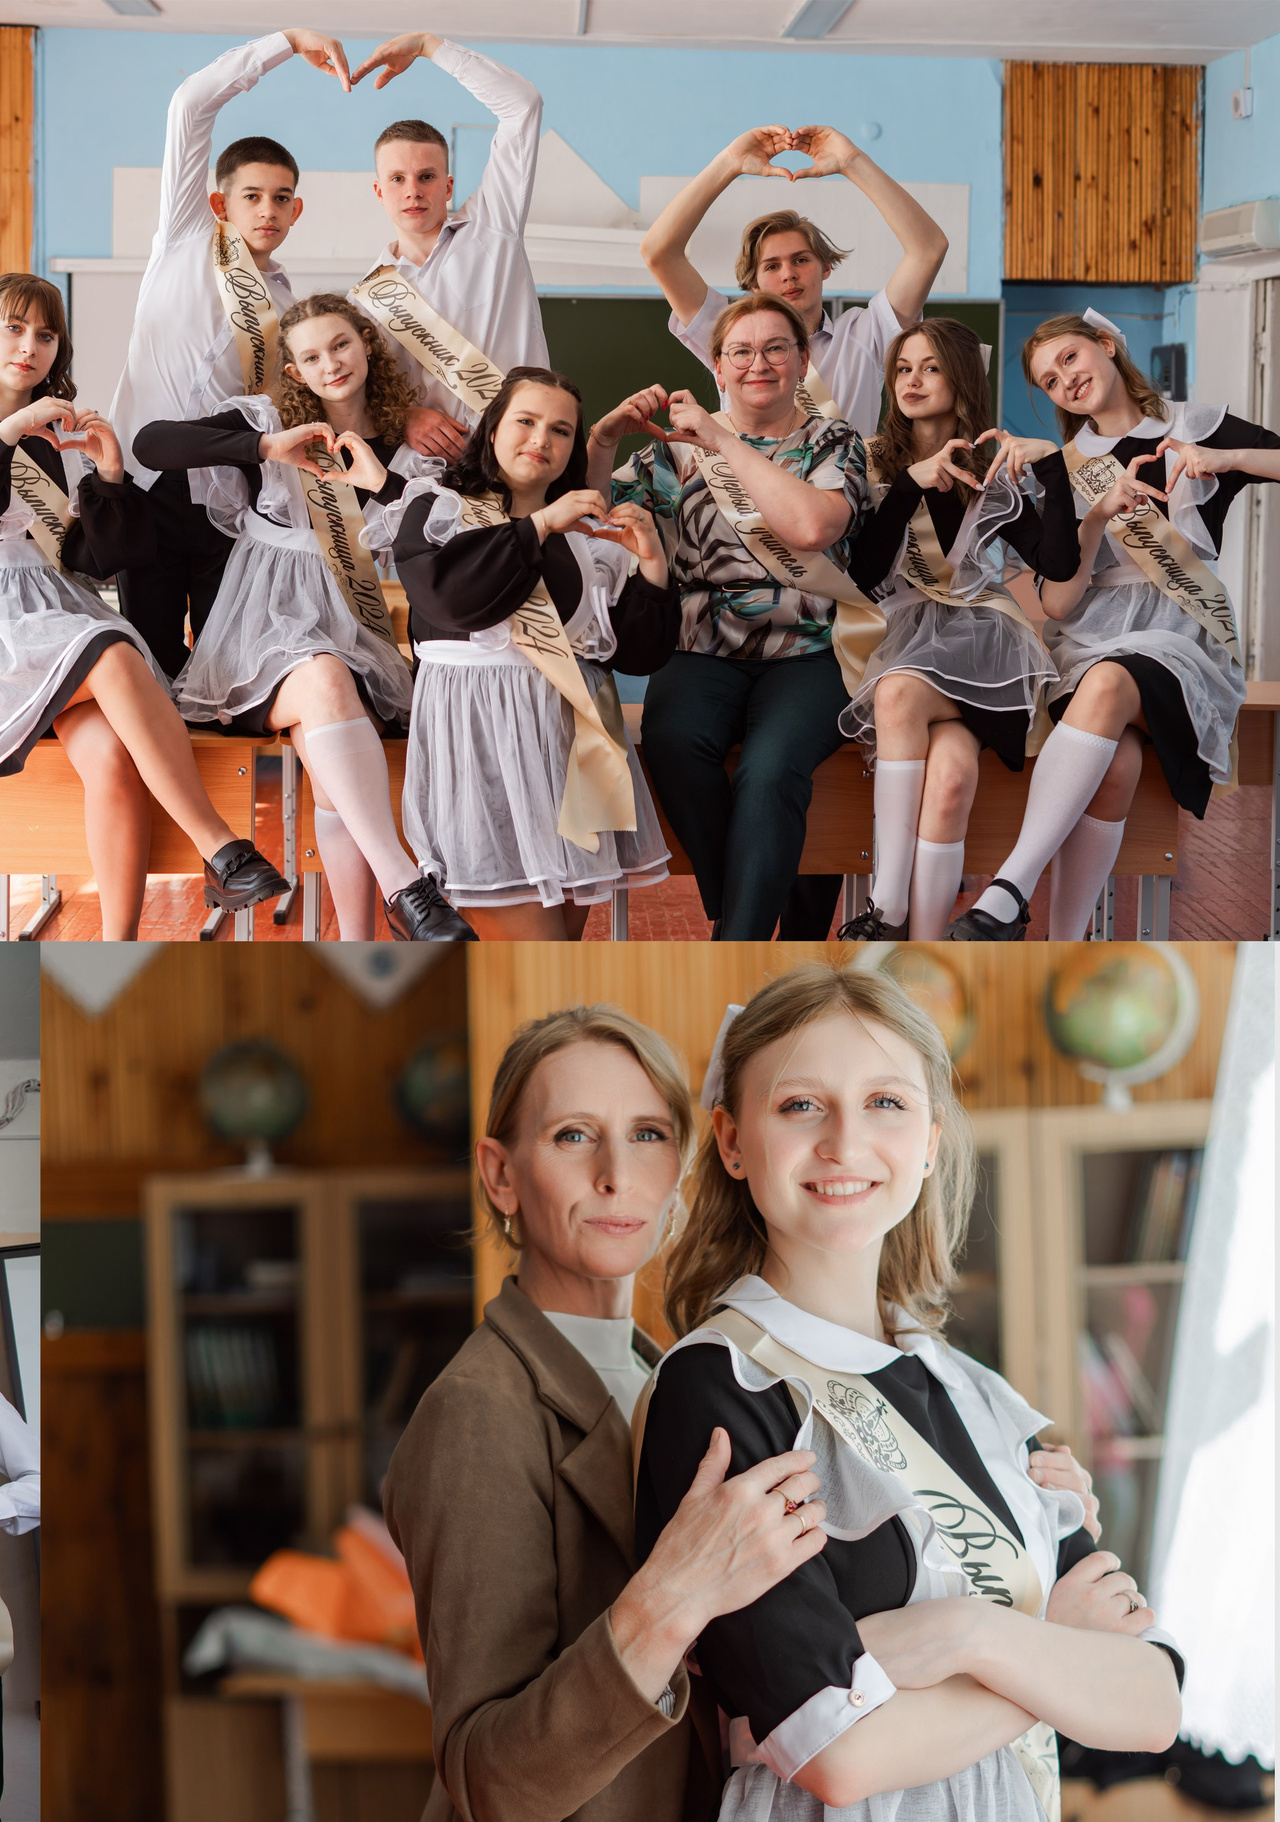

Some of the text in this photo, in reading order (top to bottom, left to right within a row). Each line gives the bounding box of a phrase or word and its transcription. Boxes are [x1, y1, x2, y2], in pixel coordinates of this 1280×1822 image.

[224, 267, 271, 388] Выпускник
[368, 280, 504, 412] Выпускник 202
[735, 521, 808, 578] учитель
[345, 574, 390, 637] 2024
